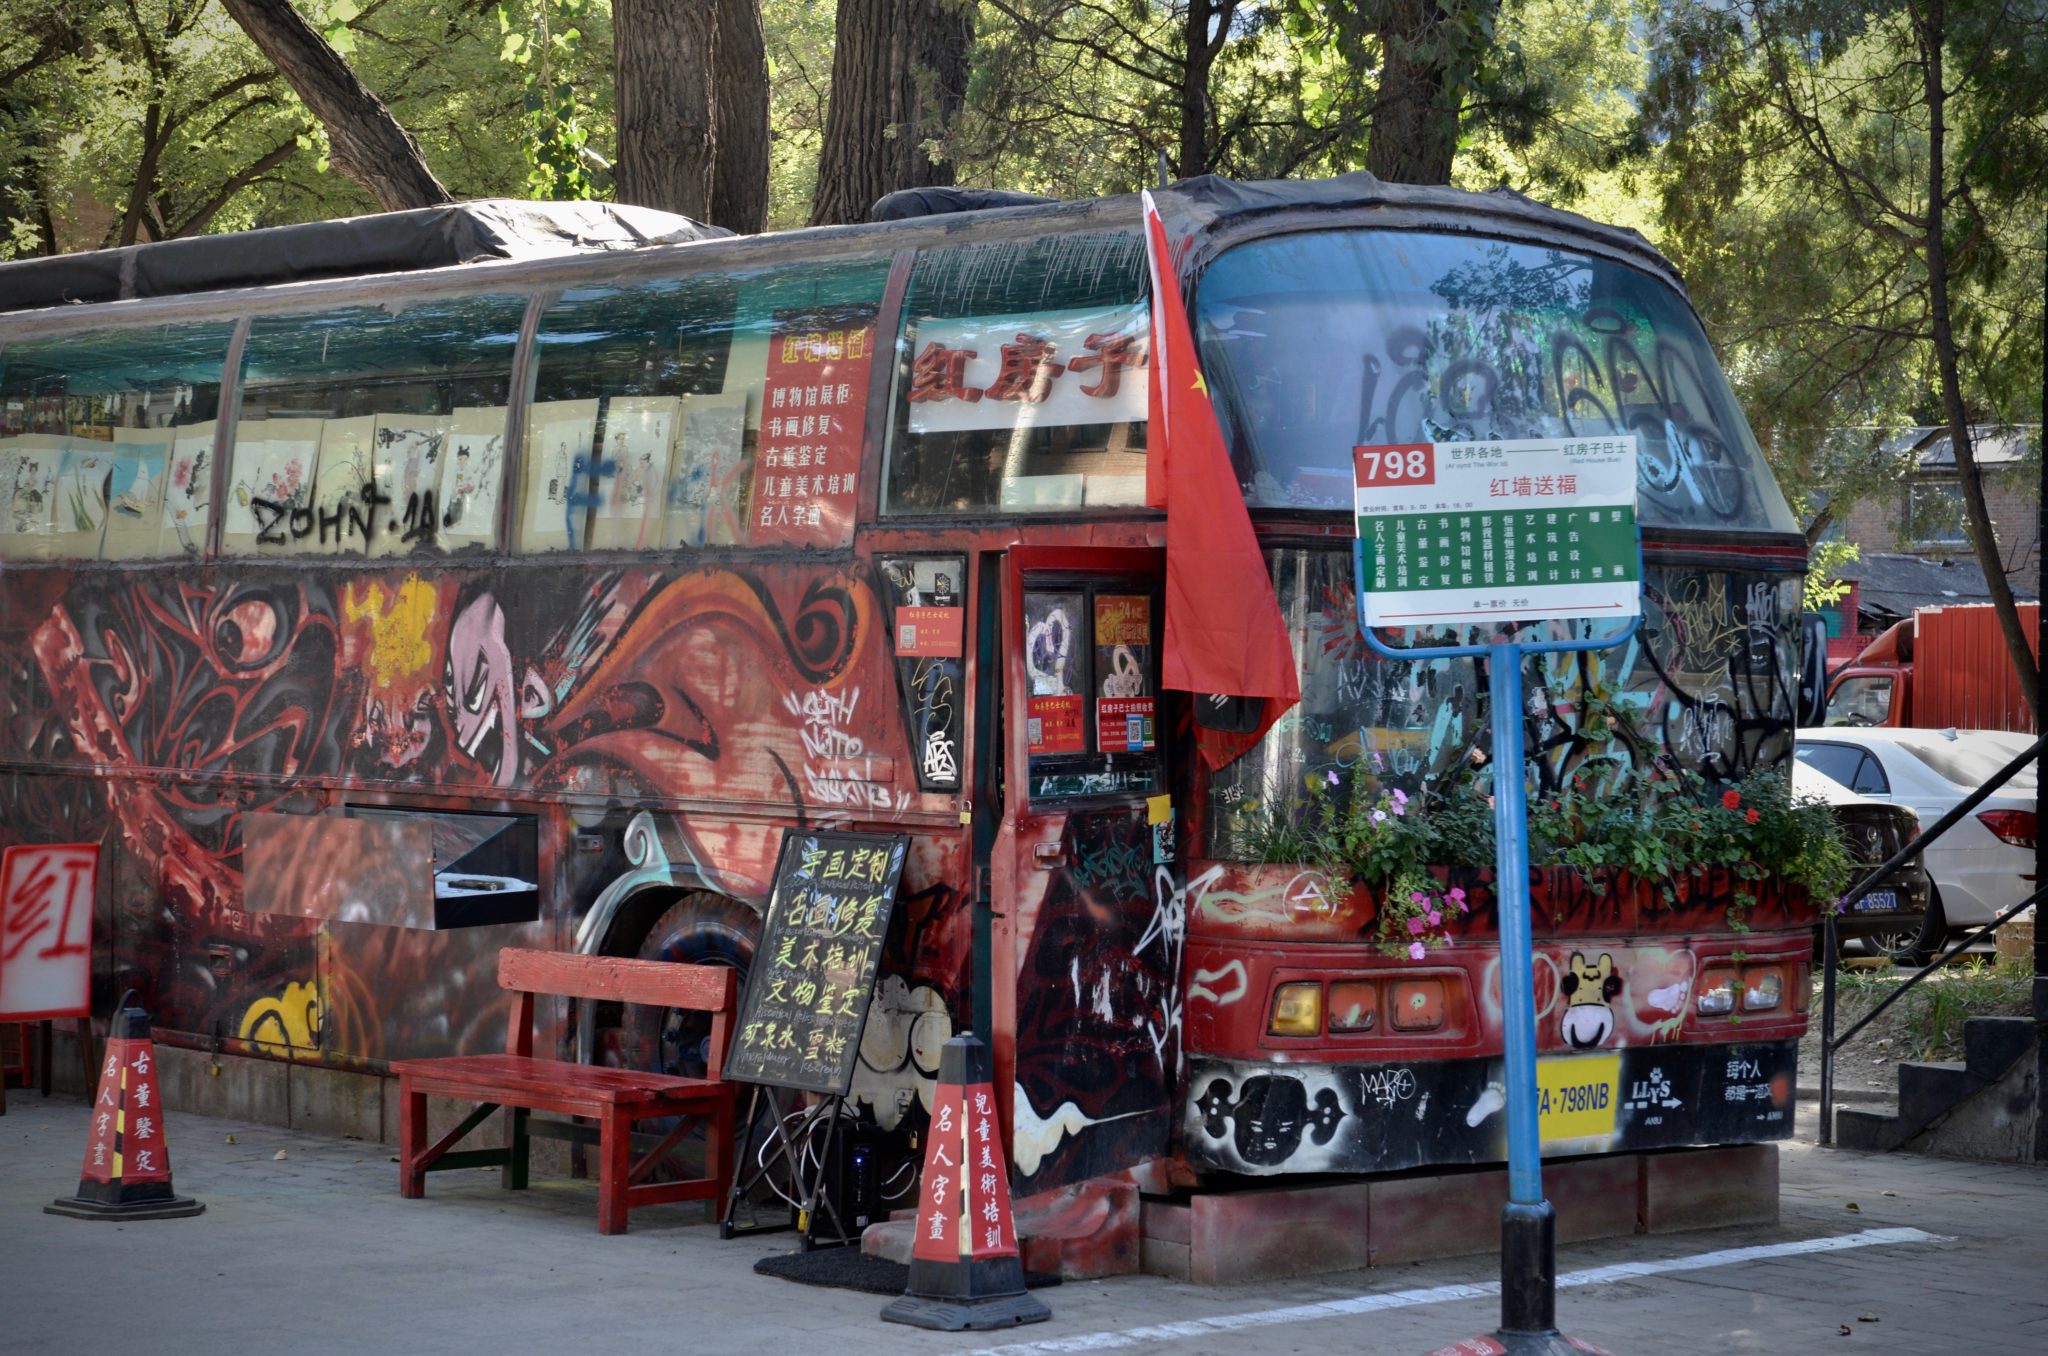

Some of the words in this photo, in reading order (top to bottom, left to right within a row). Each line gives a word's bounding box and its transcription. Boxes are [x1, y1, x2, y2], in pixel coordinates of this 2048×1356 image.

[907, 333, 1148, 403] 红房子
[772, 384, 850, 408] 博物馆展柜
[768, 415, 832, 438] 书画修复
[766, 445, 828, 467] 古董鉴定
[1363, 450, 1427, 481] 798
[1451, 446, 1503, 460] 世界各地
[1563, 441, 1627, 456] 红房子巴士
[762, 473, 855, 497] 儿童美术培训
[1489, 474, 1577, 498] 红墙送福
[760, 504, 822, 527] 名人字画
[1375, 520, 1387, 589] 名人字画定制
[1396, 519, 1408, 588] 儿童美术培训
[1568, 512, 1581, 580] 广告设计
[4, 856, 92, 962] 红
[1537, 1082, 1609, 1116] A·798NB
[927, 1104, 953, 1241] 名人字畫
